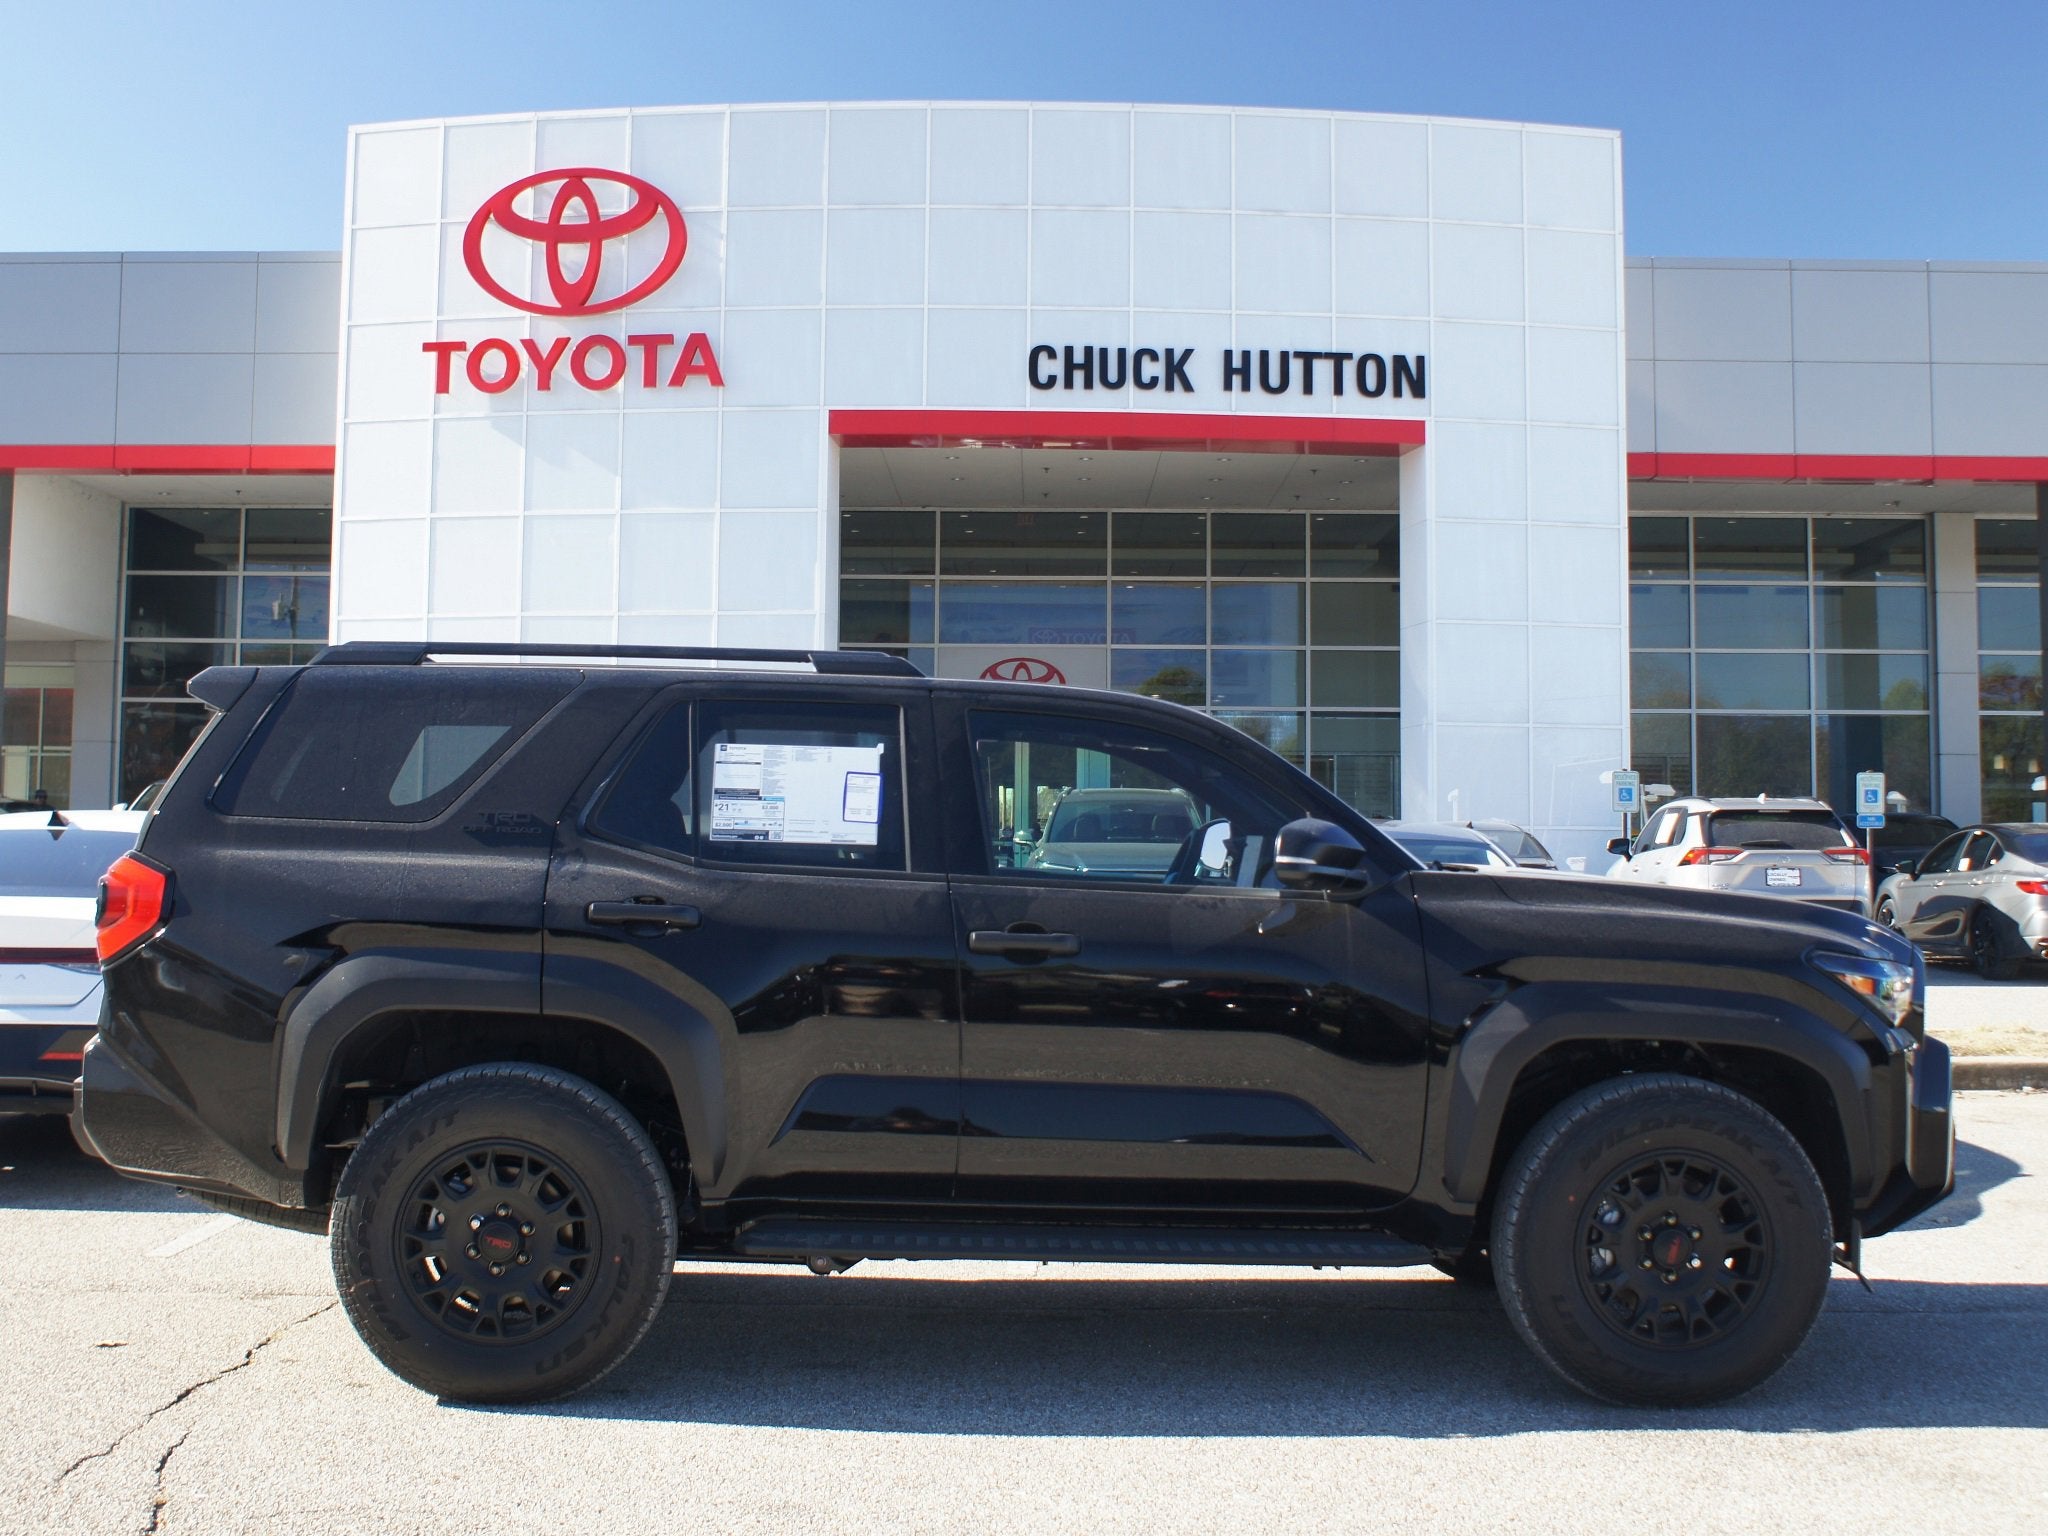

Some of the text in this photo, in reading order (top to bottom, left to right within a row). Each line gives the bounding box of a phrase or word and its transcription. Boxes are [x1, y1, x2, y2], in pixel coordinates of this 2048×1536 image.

[422, 332, 725, 394] TOYOTA
[1028, 345, 1426, 399] CHUCK HUTTON
[1062, 631, 1132, 643] TOYOTA
